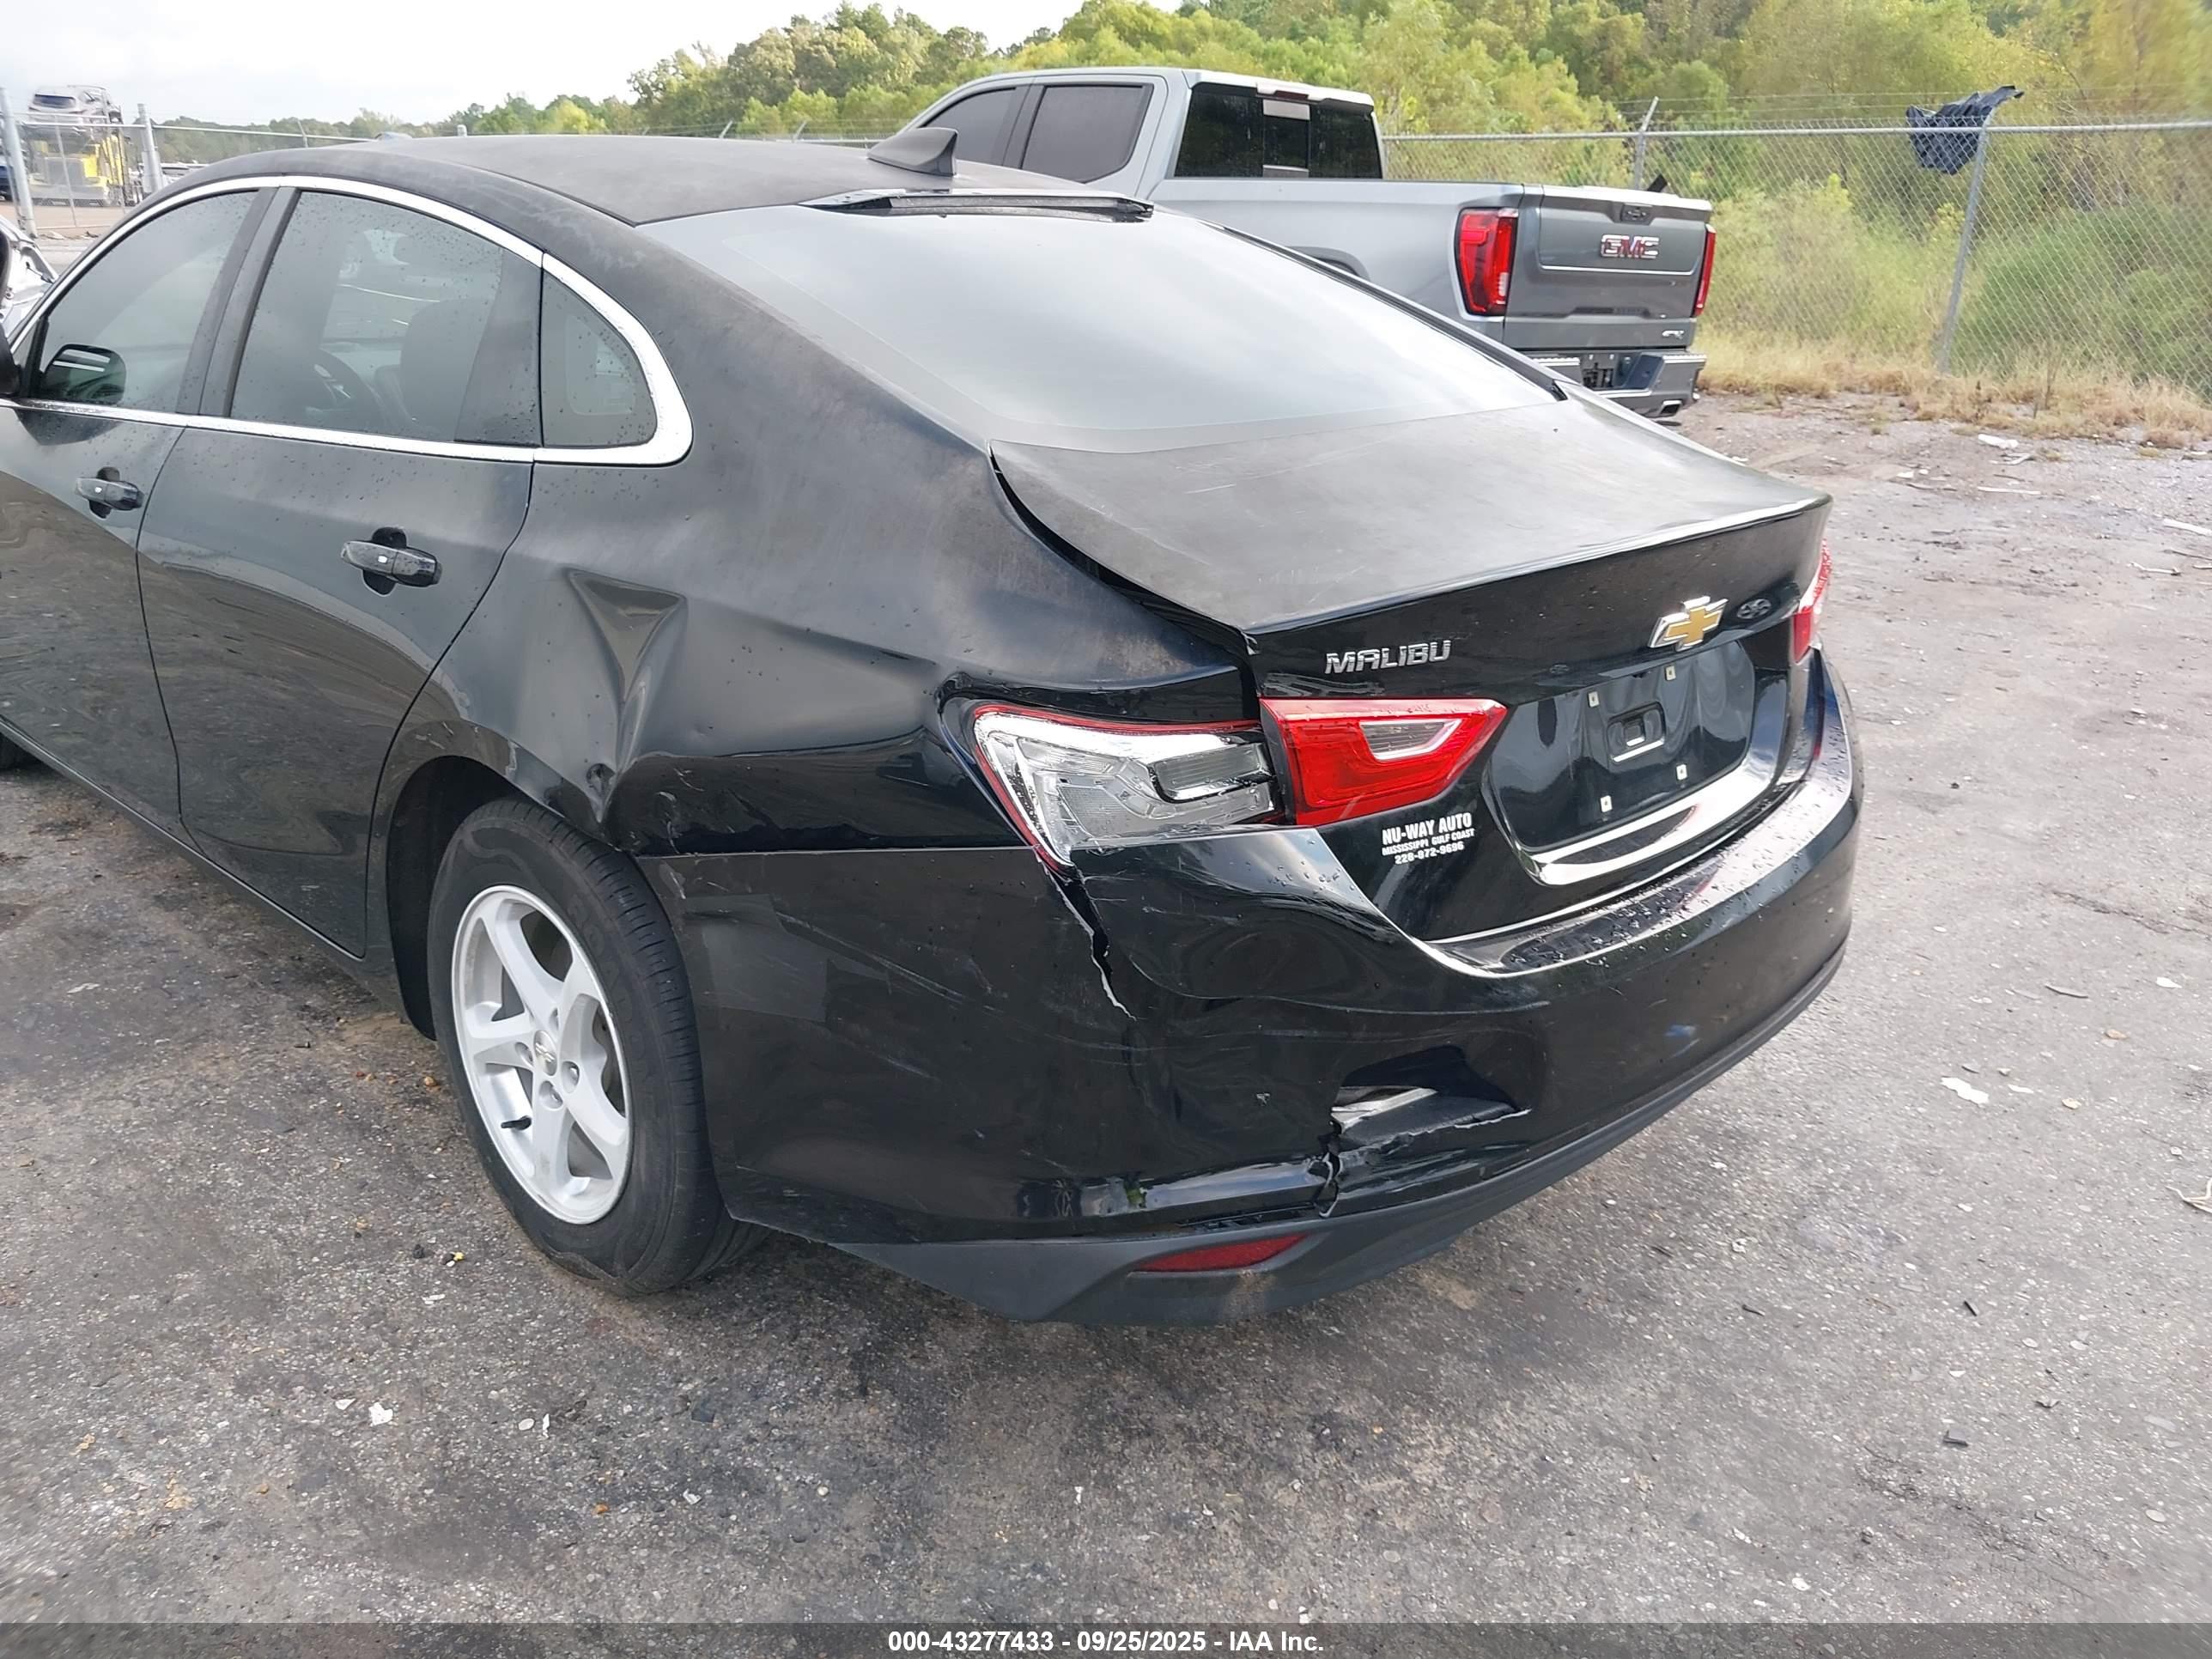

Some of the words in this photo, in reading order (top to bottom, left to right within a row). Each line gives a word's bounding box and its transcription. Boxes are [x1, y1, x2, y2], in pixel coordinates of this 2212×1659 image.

[1601, 234, 1659, 259] GMC
[1325, 640, 1451, 674] MALIBU
[1382, 819, 1435, 845] NU-WAY
[1438, 812, 1472, 833] AUTO
[1382, 838, 1429, 856] MISSISSIPPI
[1431, 833, 1450, 845] GULF
[1451, 828, 1475, 841] COAST
